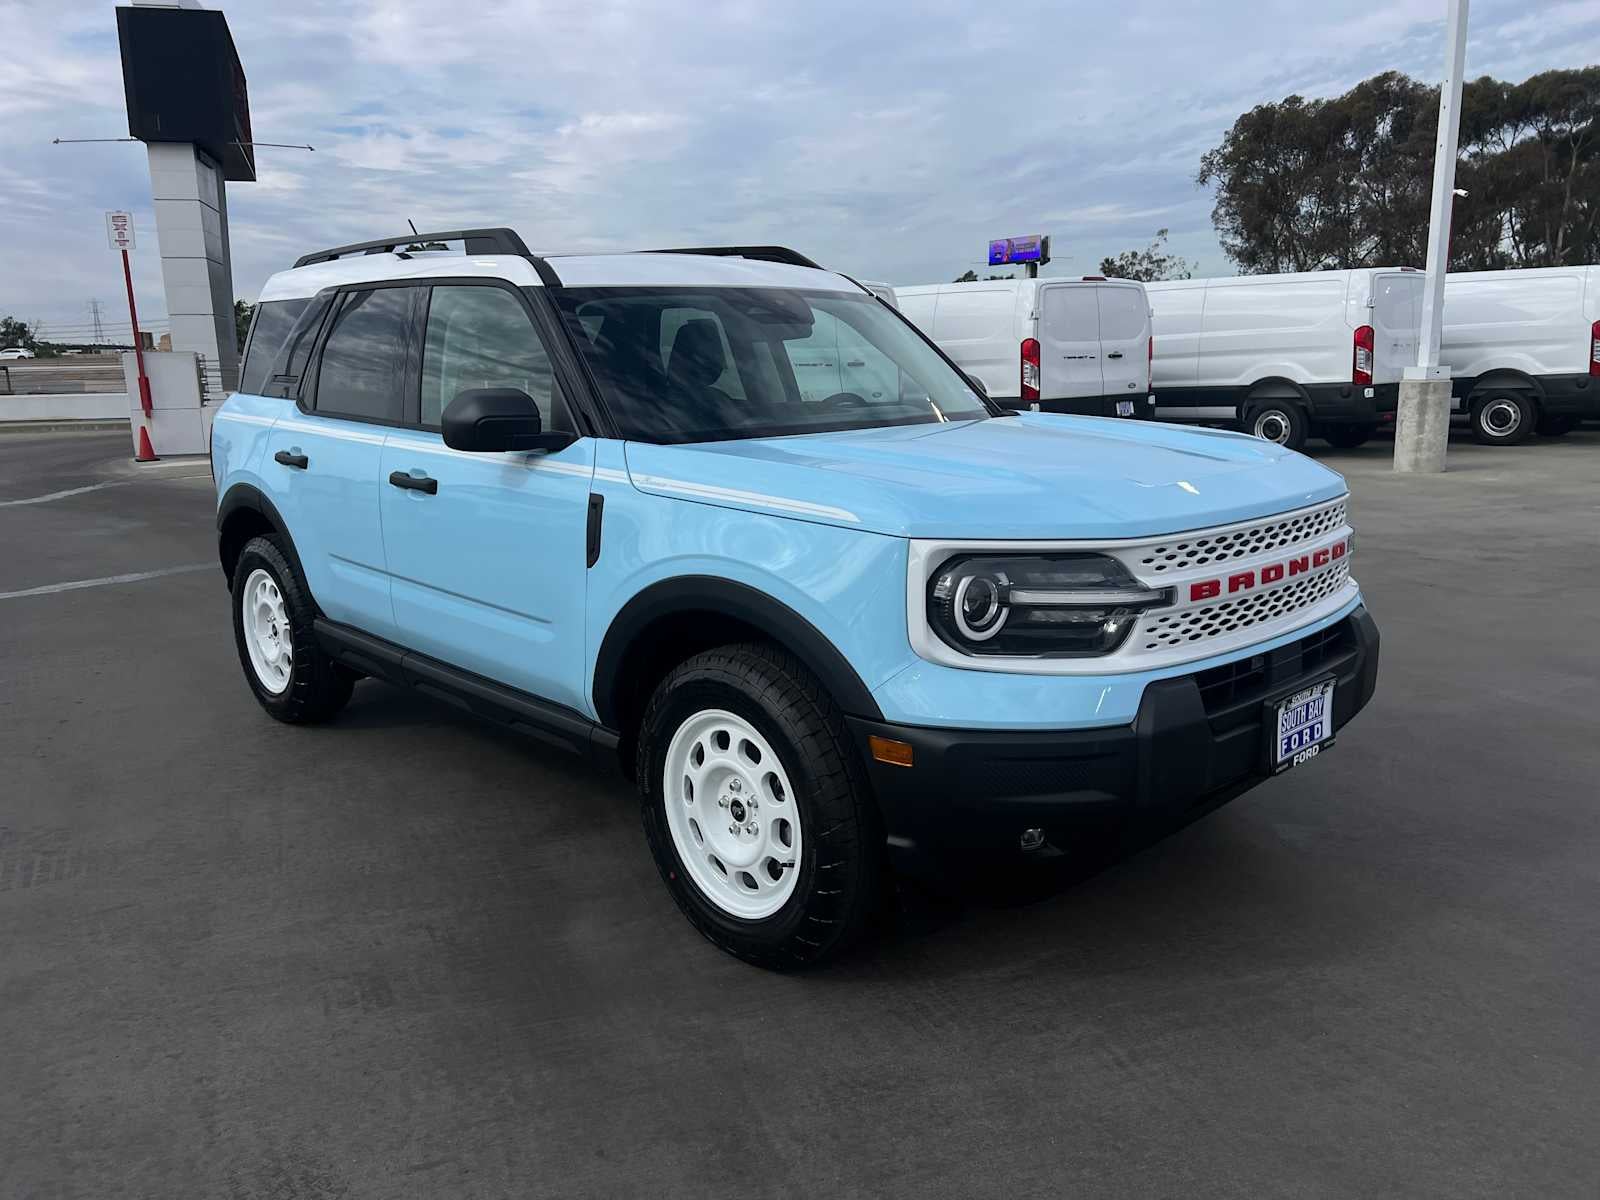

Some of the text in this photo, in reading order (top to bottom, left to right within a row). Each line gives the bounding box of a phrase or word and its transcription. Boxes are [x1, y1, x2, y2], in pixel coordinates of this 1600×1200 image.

[1190, 541, 1346, 602] BRONCO
[1281, 698, 1324, 733] SOUTH BAY
[1281, 722, 1322, 755] FORD
[1293, 744, 1319, 767] FORD
